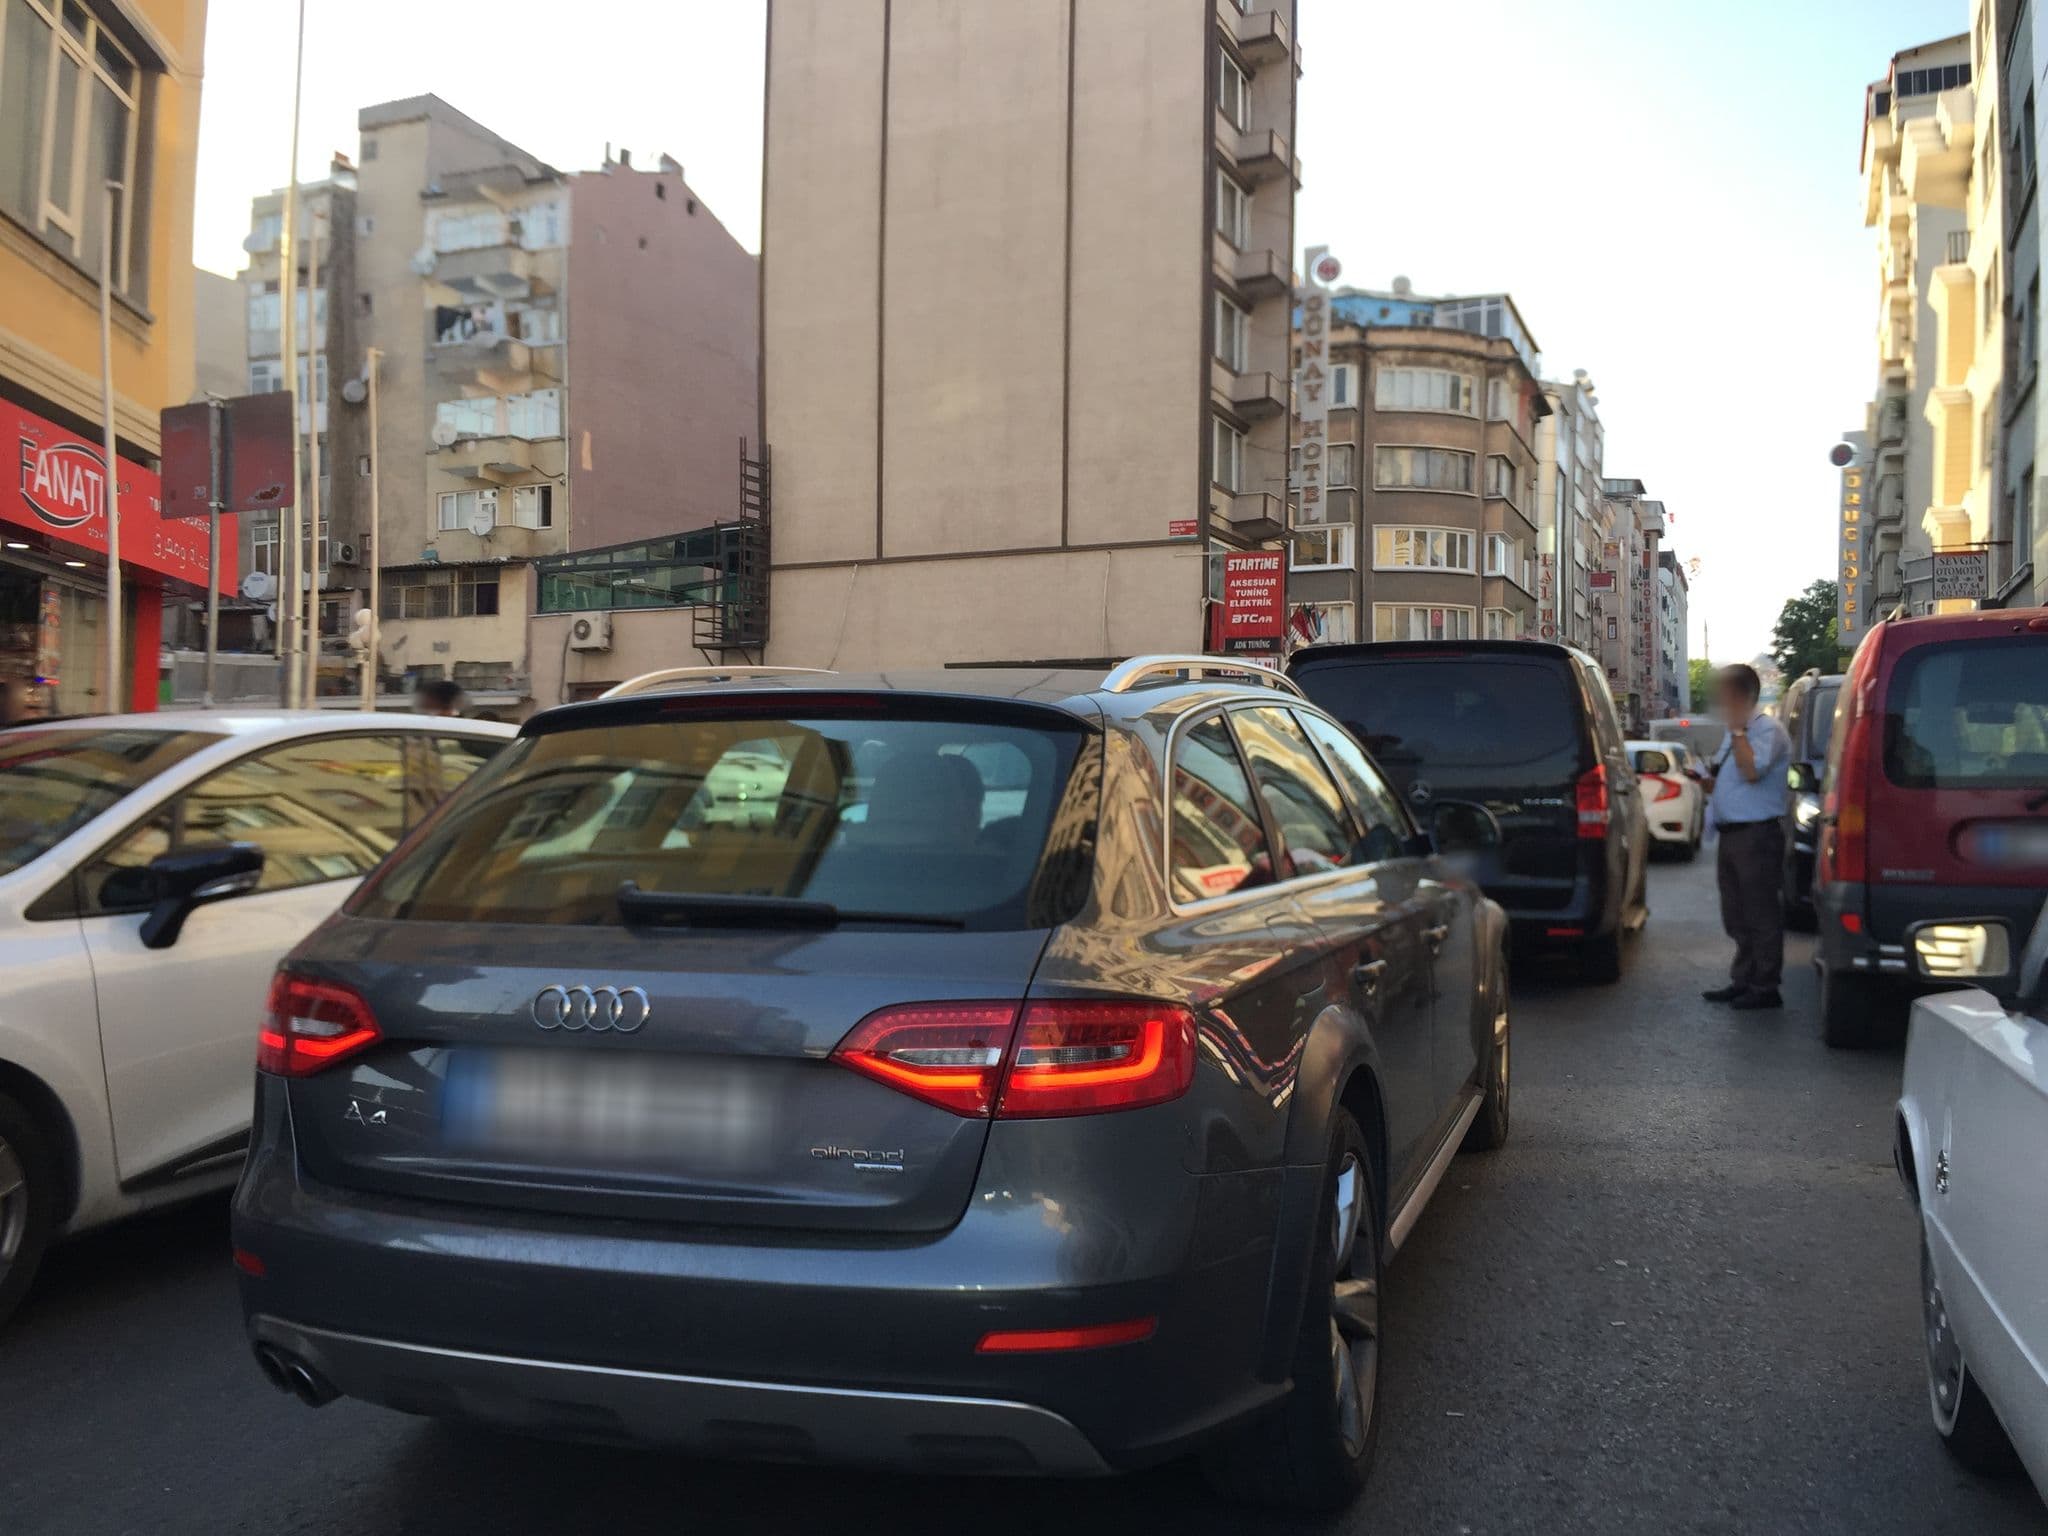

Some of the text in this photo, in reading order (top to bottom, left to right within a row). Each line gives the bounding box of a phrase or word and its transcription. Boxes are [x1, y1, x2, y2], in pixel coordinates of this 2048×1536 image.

[20, 435, 120, 523] FANATI
[1302, 419, 1323, 524] HOTEL
[1229, 579, 1277, 587] AKSESUAR
[1843, 550, 1859, 631] HOTEL
[344, 1100, 387, 1126] A4
[810, 1145, 904, 1160] allroad
